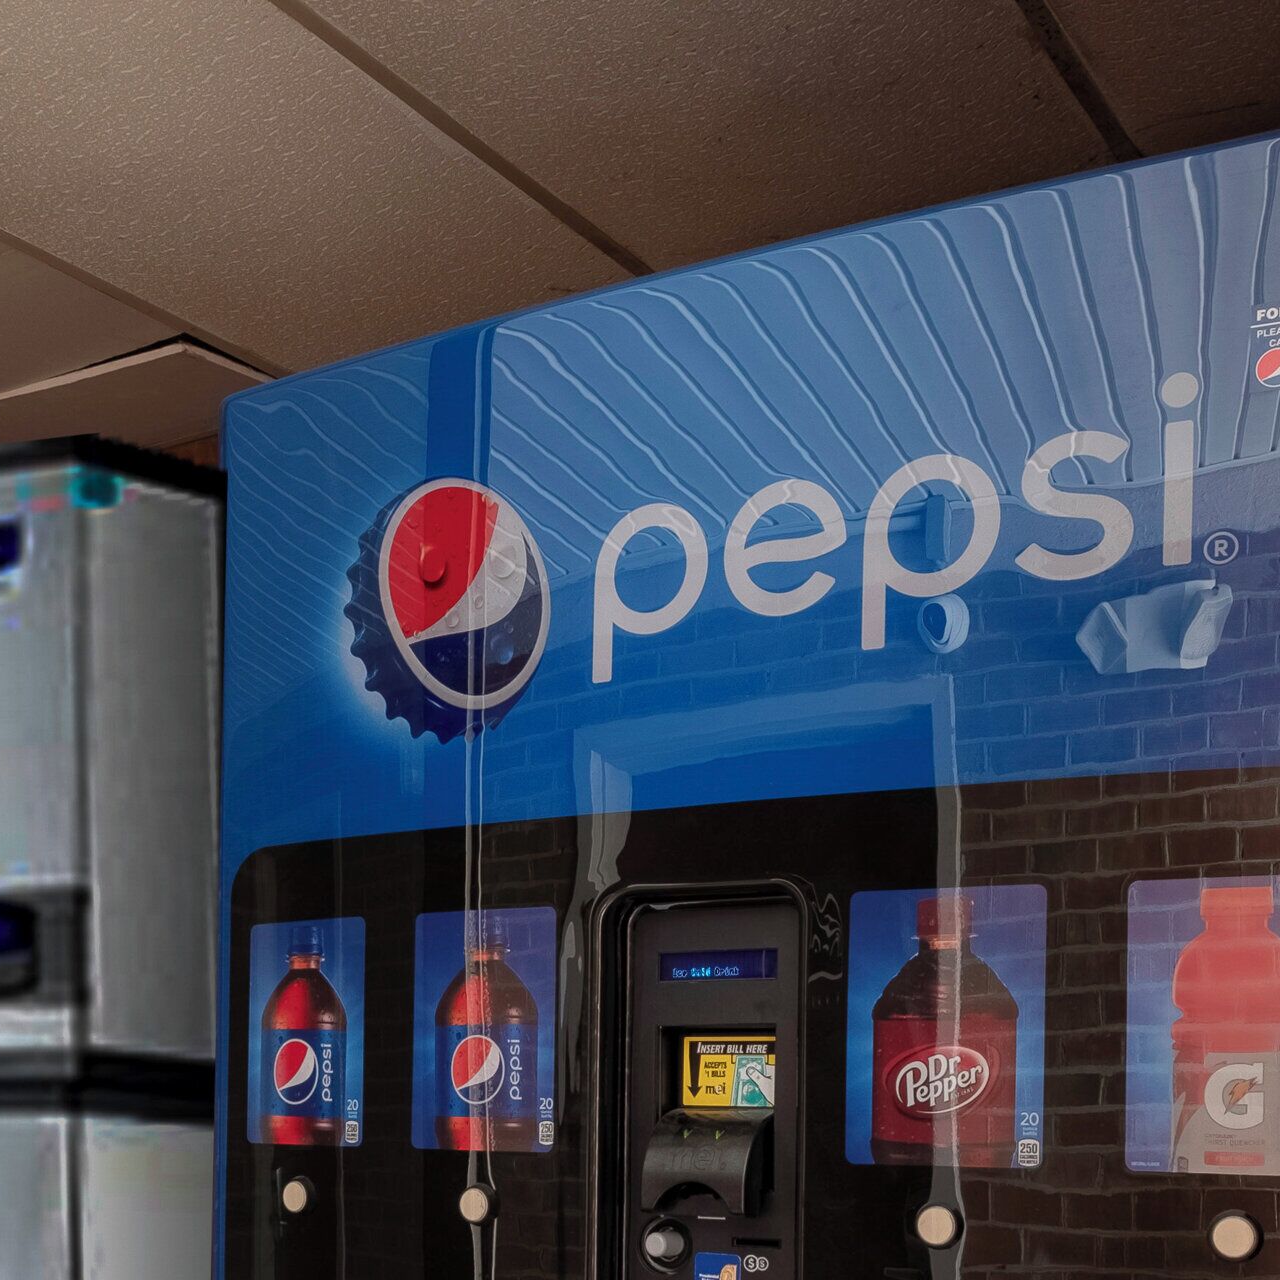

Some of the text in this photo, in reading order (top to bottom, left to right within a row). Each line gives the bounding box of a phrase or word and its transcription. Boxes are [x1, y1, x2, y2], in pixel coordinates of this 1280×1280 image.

[591, 371, 1198, 684] pepsi
[696, 1041, 768, 1054] INSERT BILL HERE
[320, 1043, 334, 1102] pepsi
[507, 1039, 523, 1100] pepsi
[927, 1054, 962, 1082] Dr
[896, 1060, 983, 1108] Pepper
[1204, 1062, 1264, 1130] G
[347, 1099, 359, 1111] 20
[539, 1097, 554, 1110] 20
[1020, 1112, 1040, 1126] 20
[1020, 1143, 1038, 1154] 250
